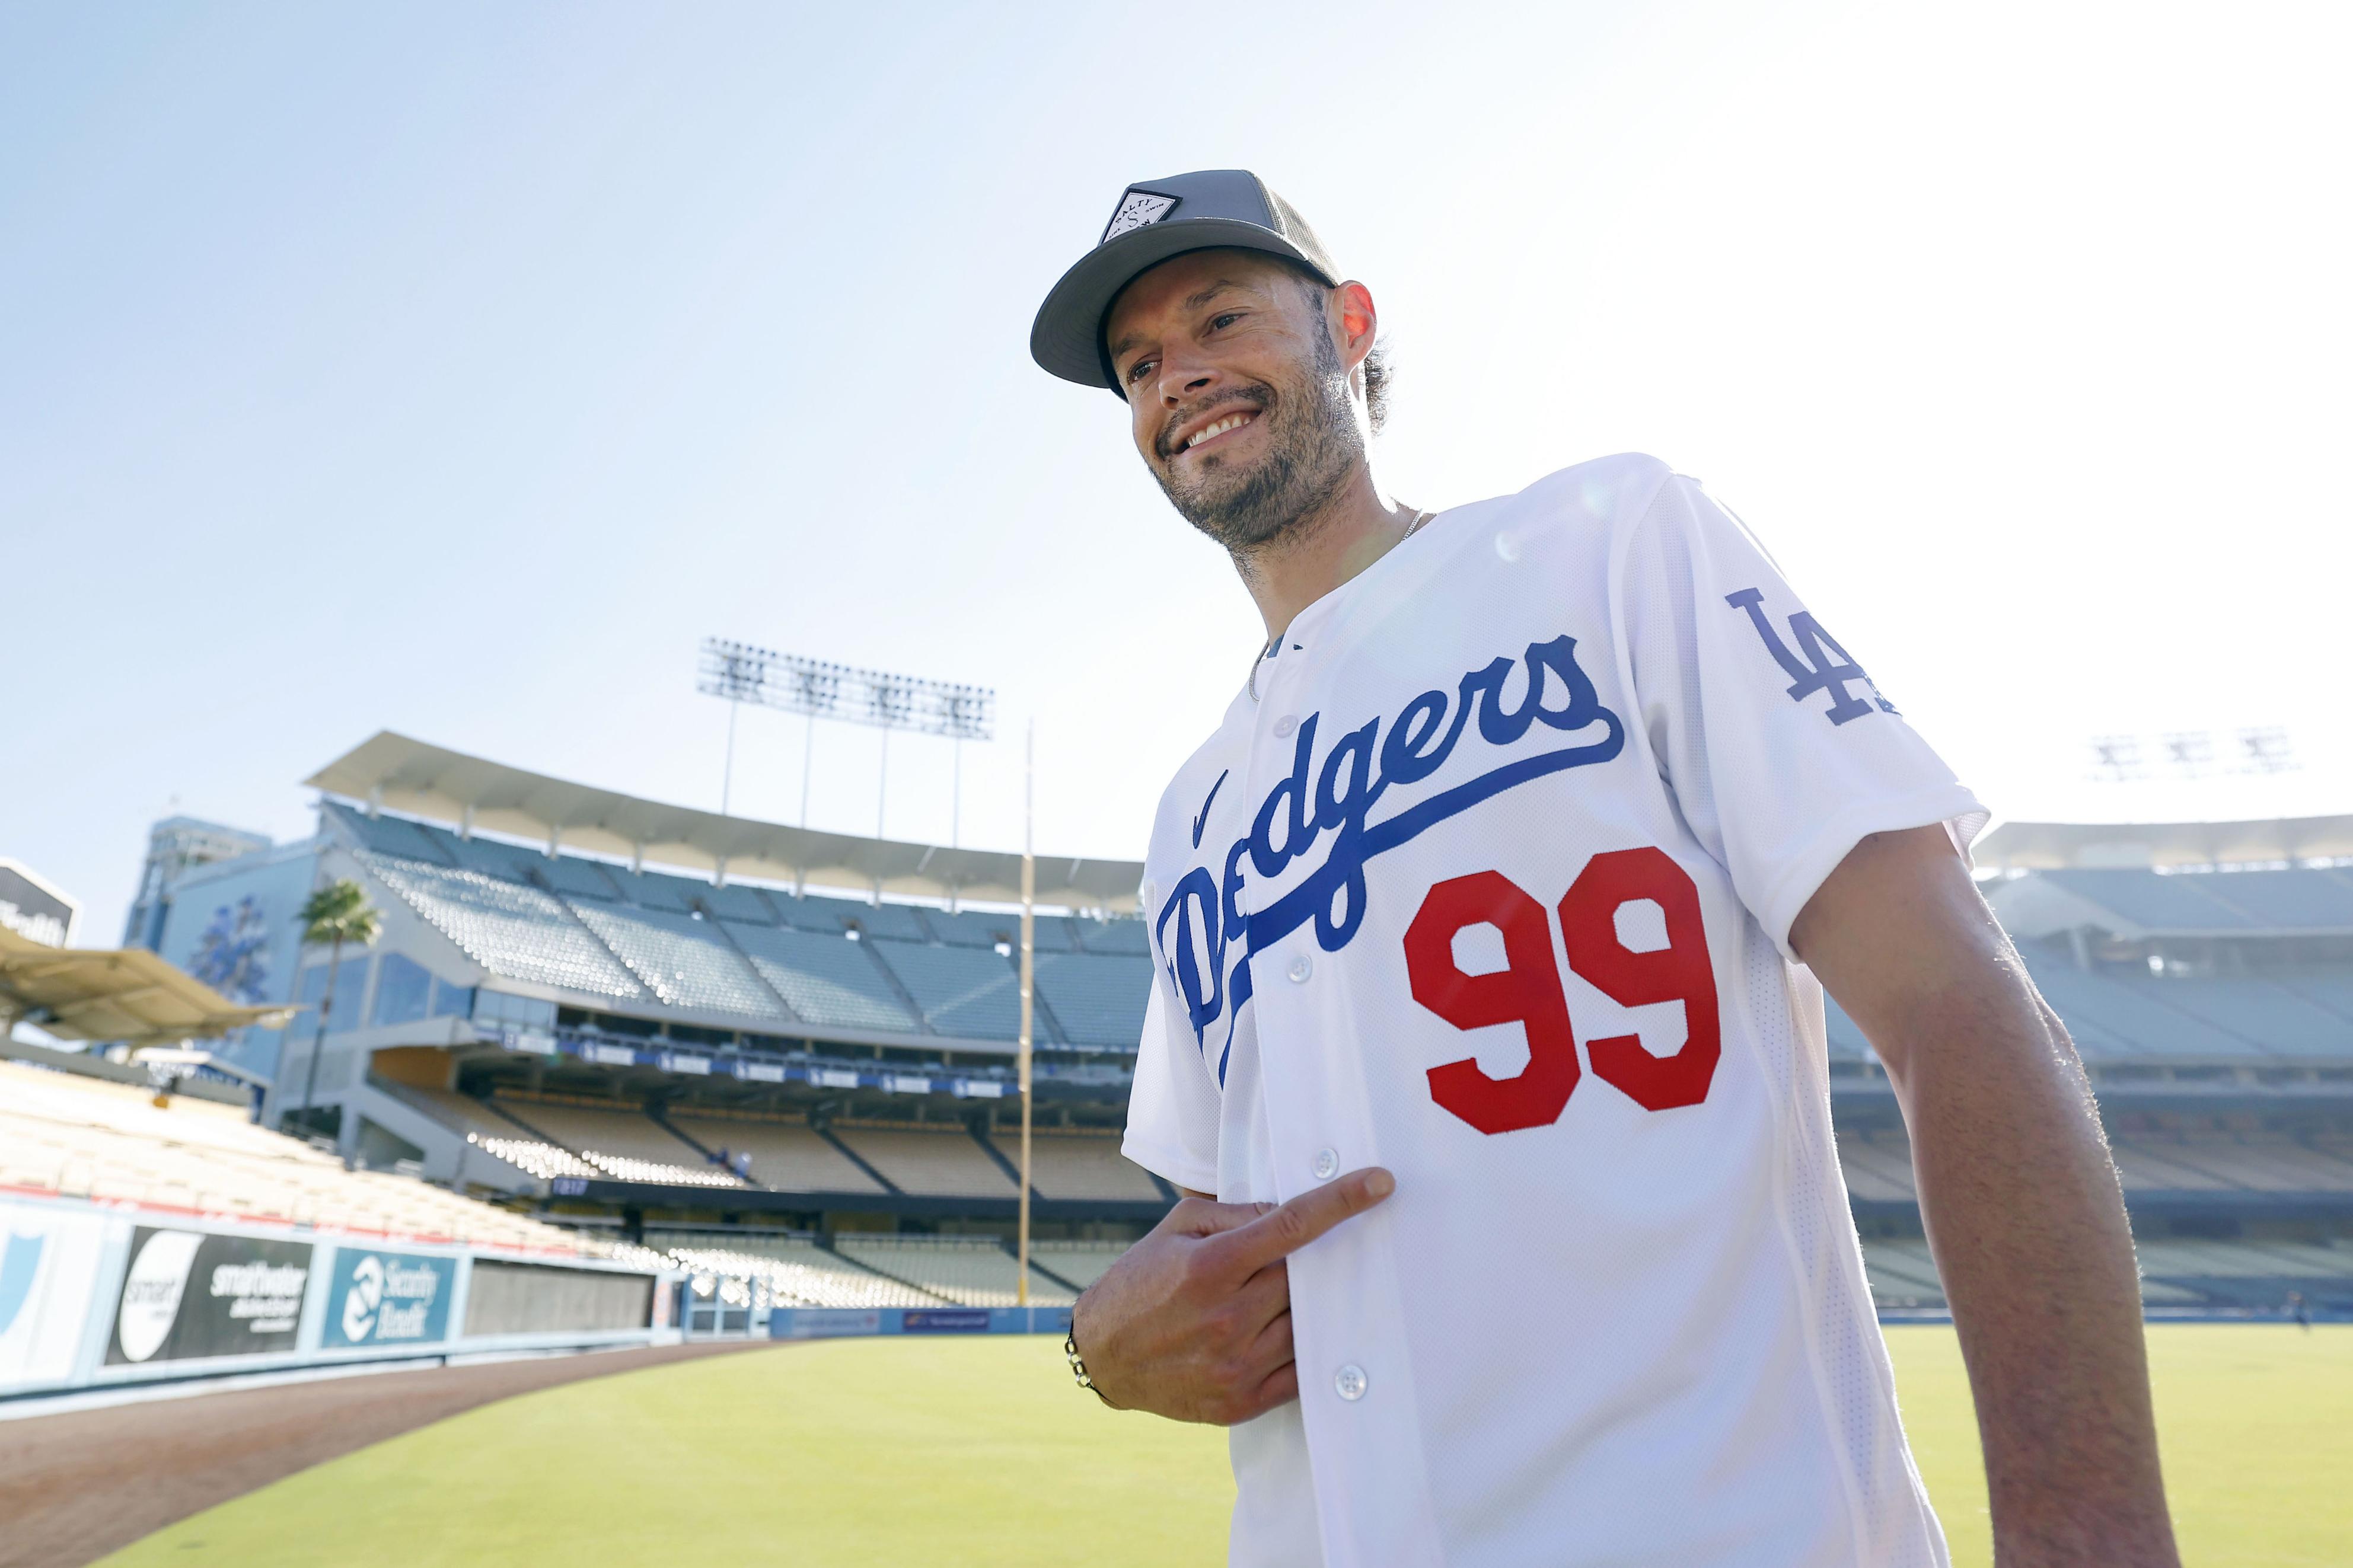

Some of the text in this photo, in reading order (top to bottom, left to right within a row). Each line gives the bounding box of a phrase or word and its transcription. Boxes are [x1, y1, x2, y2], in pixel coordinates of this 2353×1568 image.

[1115, 199, 1153, 223] SALTY
[1724, 587, 1902, 726] LA
[1156, 635, 1625, 1089] Dodgers
[1404, 848, 1720, 1134] 99
